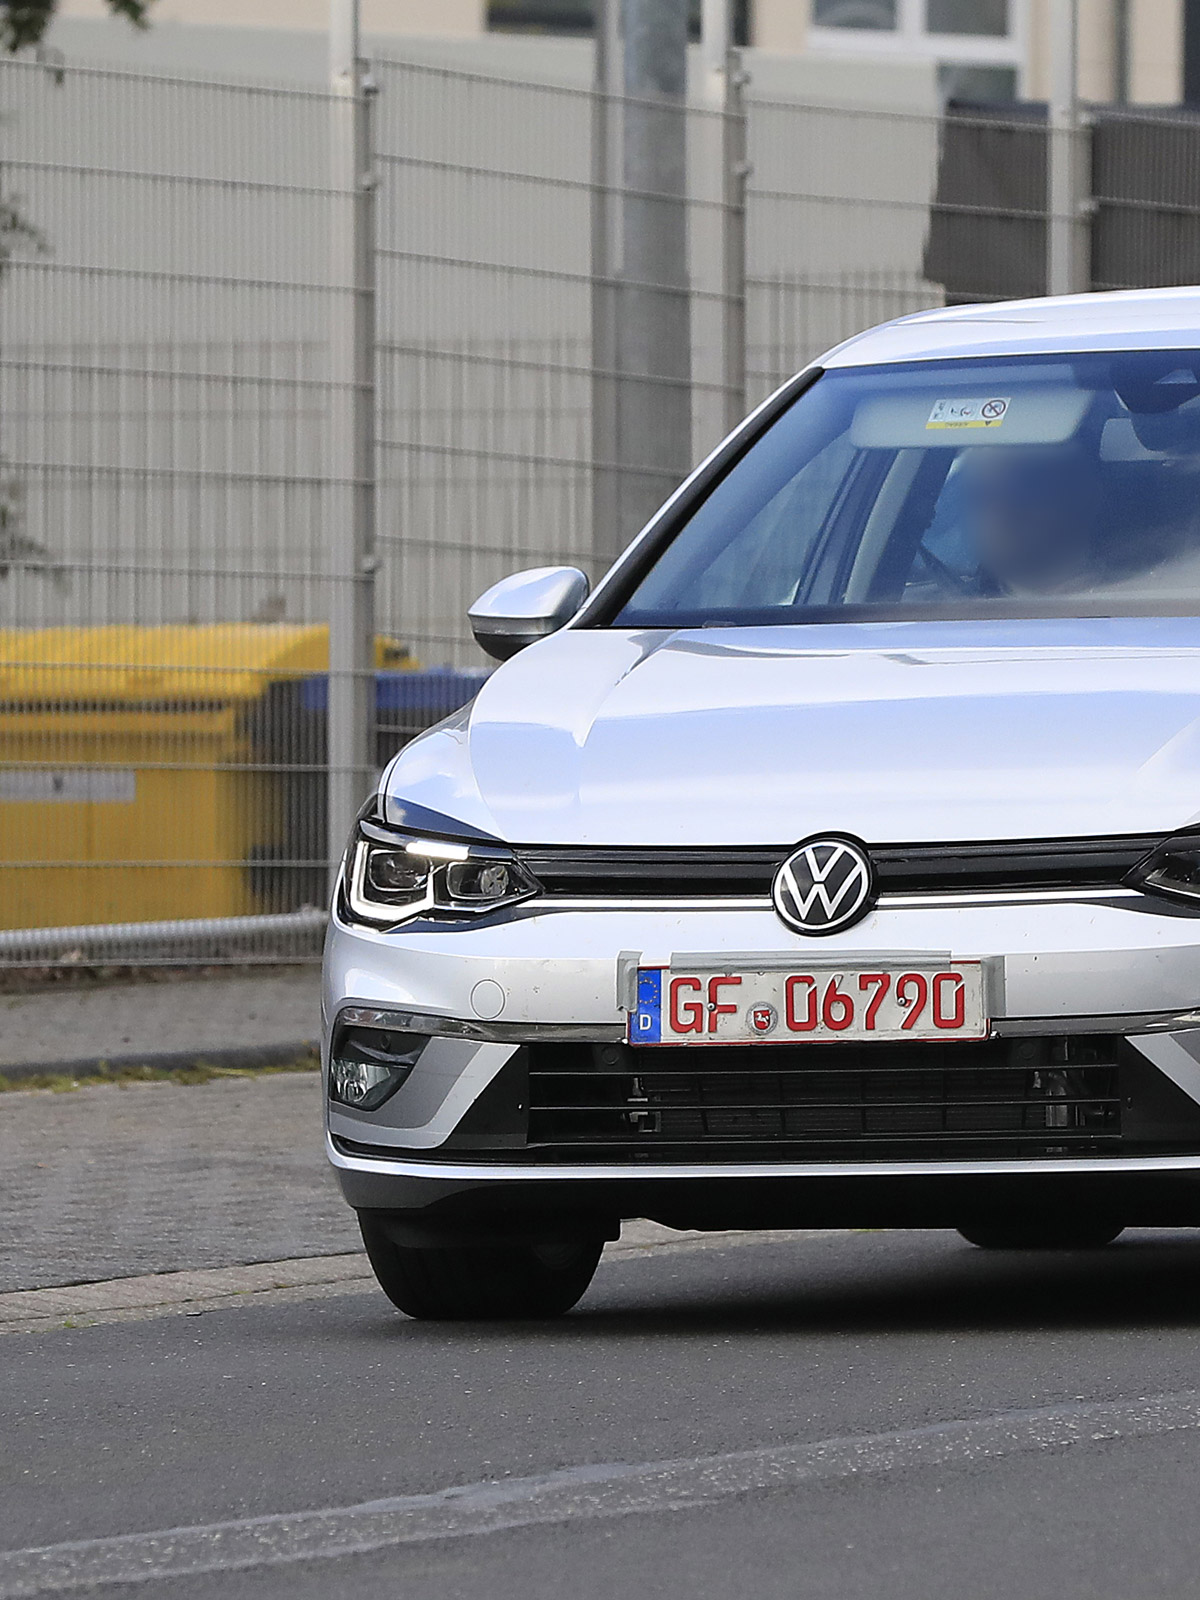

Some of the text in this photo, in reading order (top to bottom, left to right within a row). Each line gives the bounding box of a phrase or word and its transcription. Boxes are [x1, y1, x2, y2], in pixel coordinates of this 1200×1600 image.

[781, 843, 866, 923] VW
[639, 1014, 652, 1031] D
[670, 972, 965, 1033] GF 06790
